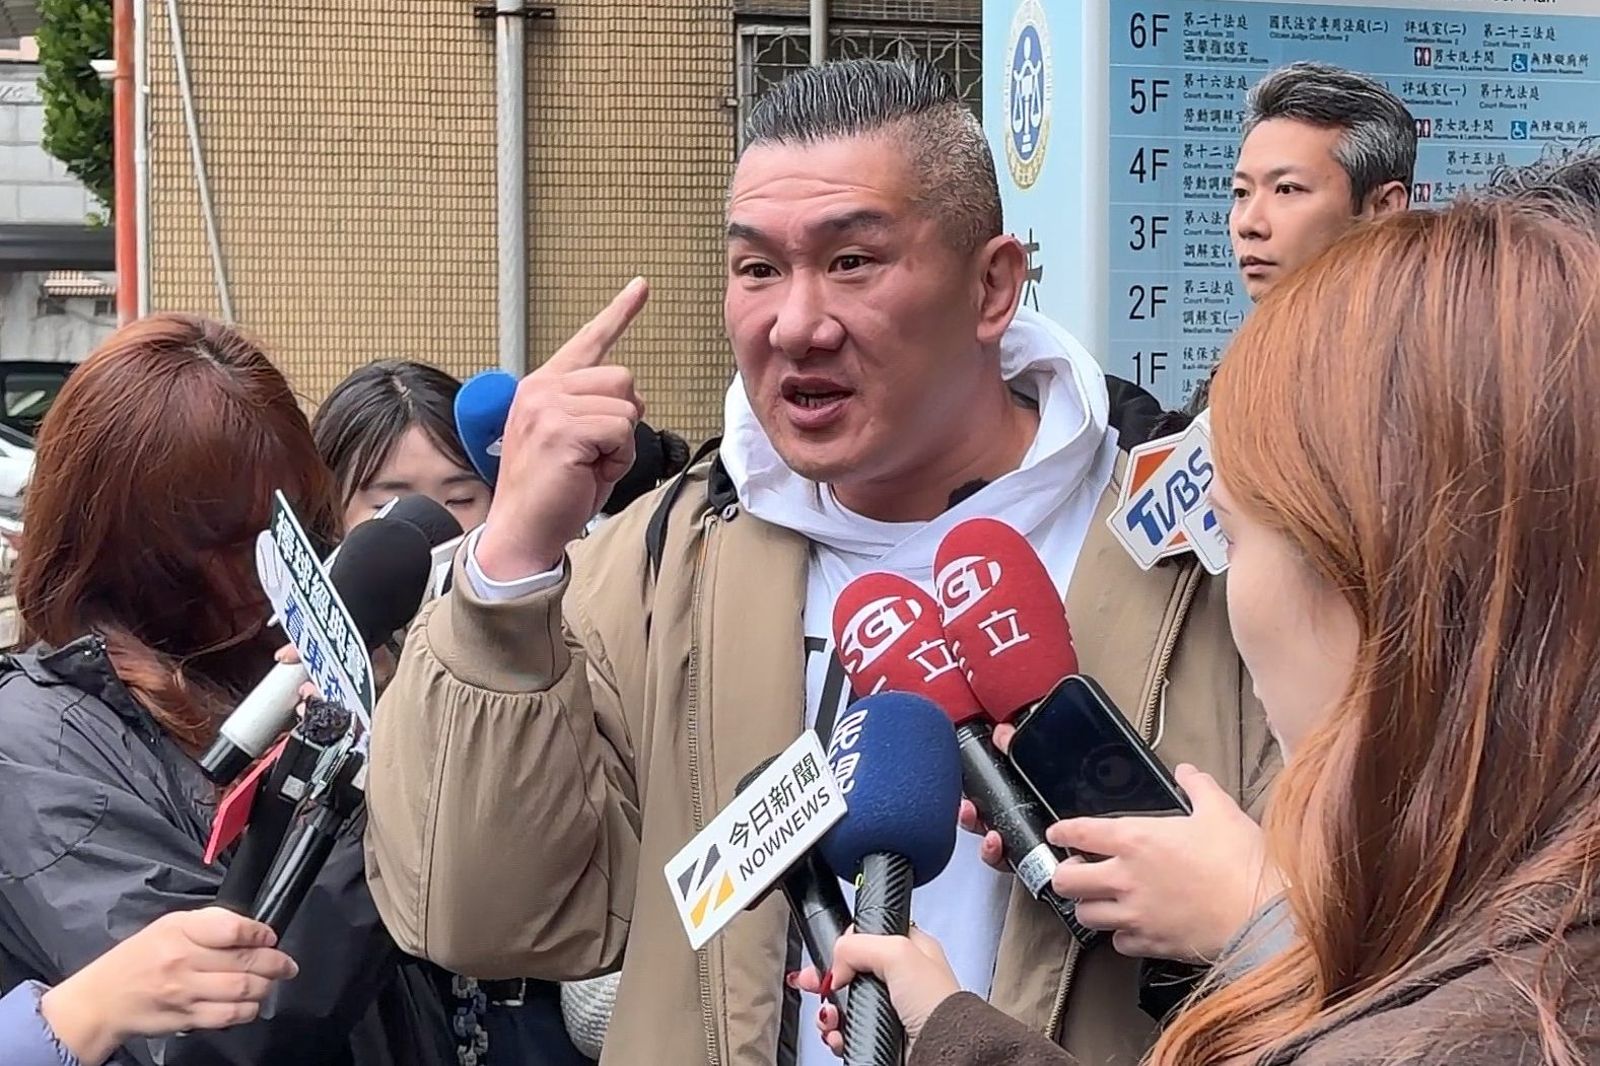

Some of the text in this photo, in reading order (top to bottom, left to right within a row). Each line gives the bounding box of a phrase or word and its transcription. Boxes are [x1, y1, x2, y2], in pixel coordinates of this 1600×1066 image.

[1184, 11, 1249, 30] 第二十法庭
[1269, 15, 1389, 34] 國民法官專用法庭(二)
[1404, 20, 1467, 36] 評議室(二)
[1130, 12, 1170, 49] 6F
[1483, 22, 1556, 41] 第二十三法庭
[1434, 48, 1495, 64] 男女洗手間
[1184, 73, 1249, 91] 第十六法庭
[1402, 82, 1467, 97] 評議室(一)
[1130, 79, 1170, 115] 5F
[1480, 83, 1540, 101] 第十九法庭
[1434, 118, 1494, 133] 男女洗手間
[1129, 147, 1170, 184] 4F
[1130, 215, 1170, 251] 3F
[1184, 279, 1235, 296] 第三法庭
[1129, 285, 1169, 320] 2F
[1183, 310, 1244, 326] 調解室(一)
[1132, 352, 1168, 387] 1F
[1126, 446, 1214, 546] TVBS
[828, 709, 869, 794] 民視
[728, 752, 821, 849] 今日新聞
[738, 786, 830, 882] NOWNEWS
